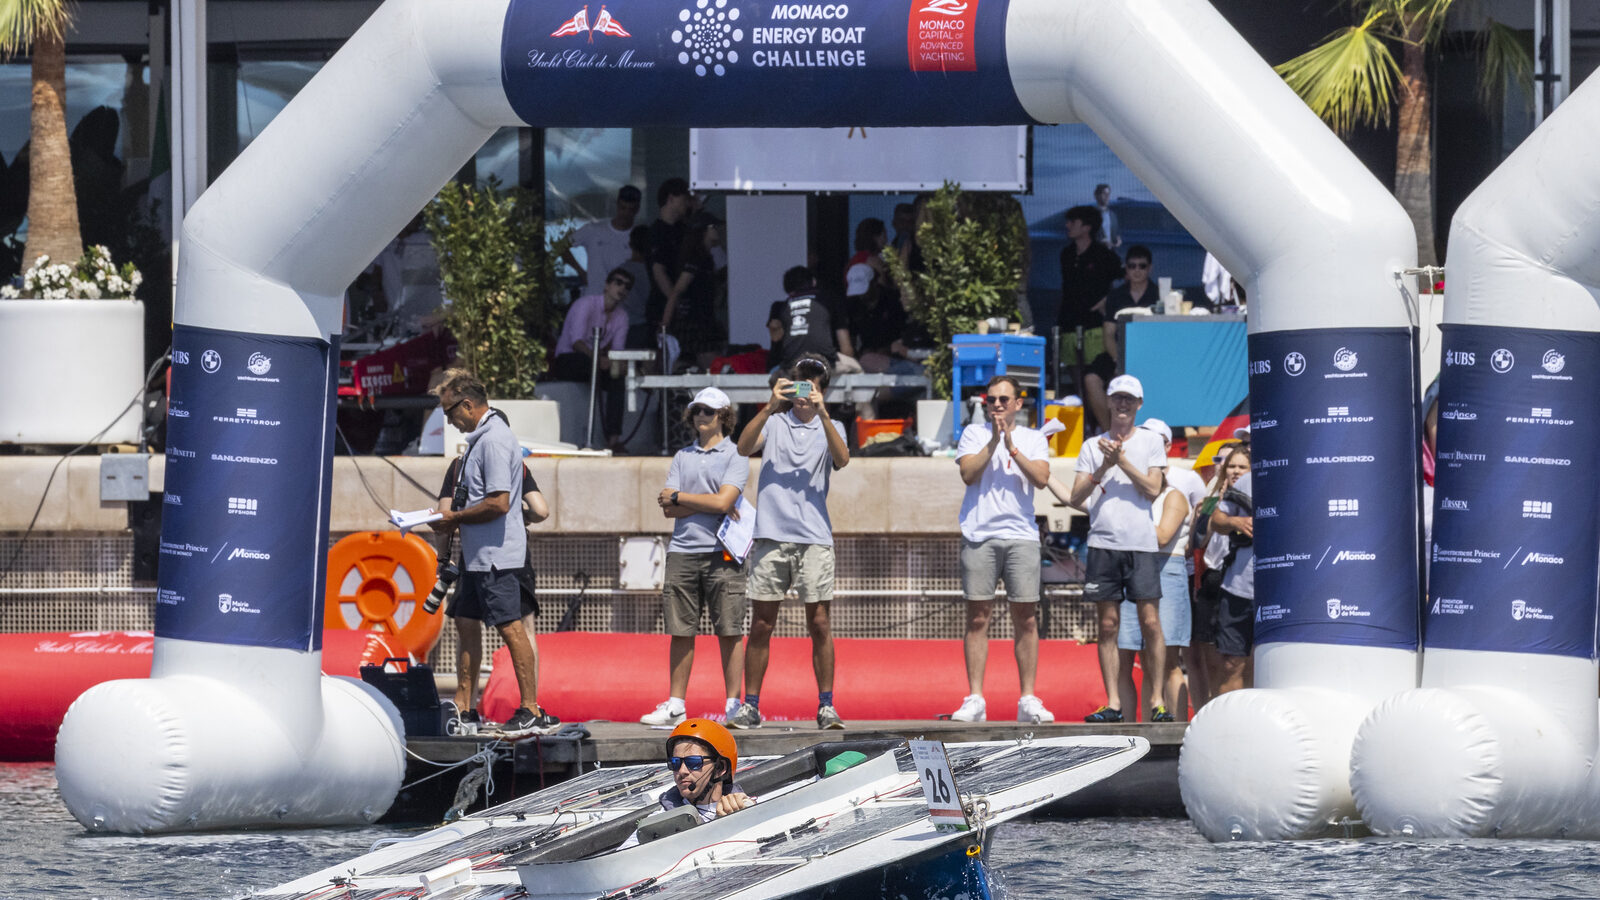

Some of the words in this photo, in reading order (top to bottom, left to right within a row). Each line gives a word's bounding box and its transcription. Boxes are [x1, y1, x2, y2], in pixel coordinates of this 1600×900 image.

[771, 4, 849, 20] MONACO
[920, 20, 965, 30] MONACO
[753, 27, 818, 44] ENERGY
[821, 27, 866, 44] BOAT
[919, 30, 953, 40] CAPITAL
[920, 41, 964, 50] ADVANCED
[527, 49, 562, 68] Yacht
[562, 49, 597, 68] Club
[595, 54, 607, 68] de
[609, 49, 656, 68] Monaco
[752, 50, 866, 67] CHALLENGE
[919, 51, 965, 61] YACHTING
[1454, 351, 1476, 366] UBS
[1253, 359, 1272, 374] UBS
[211, 453, 278, 465] SANLORENZO
[1306, 455, 1375, 464] SANLORENZO
[1456, 450, 1486, 461] BENETTI
[1504, 455, 1571, 466] SANLORENZO
[185, 543, 209, 553] Princier
[1474, 549, 1501, 558] Princier
[228, 547, 271, 561] Monaco
[1285, 553, 1312, 561] Princier
[1332, 550, 1376, 565] Monaco
[1521, 552, 1564, 566] Monaco
[232, 600, 250, 608] Mairie
[240, 606, 261, 614] Monaco
[34, 640, 74, 654] Yacht
[925, 767, 951, 804] 26
